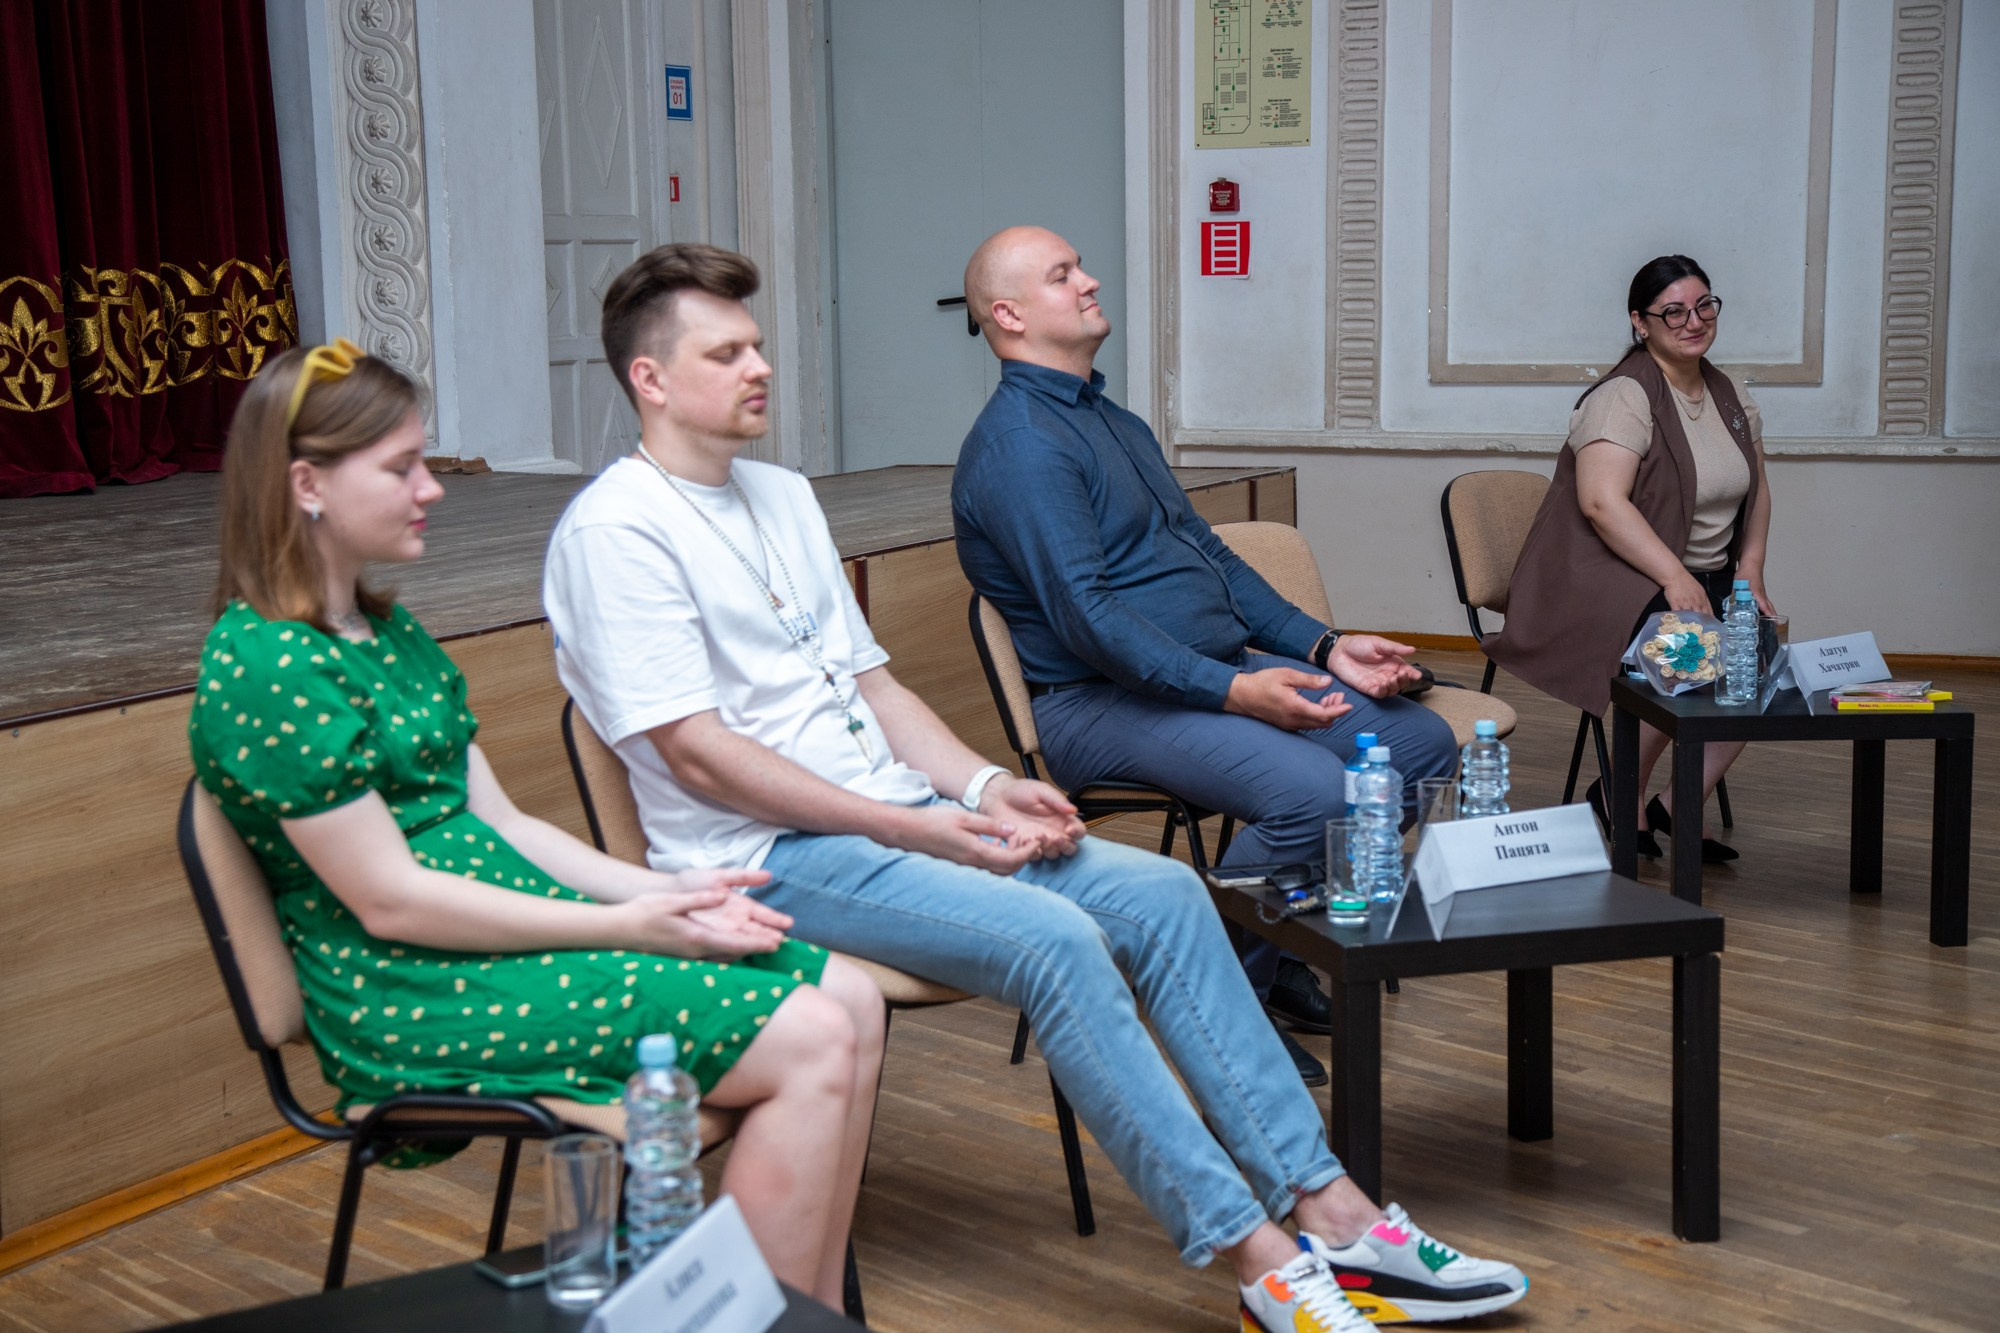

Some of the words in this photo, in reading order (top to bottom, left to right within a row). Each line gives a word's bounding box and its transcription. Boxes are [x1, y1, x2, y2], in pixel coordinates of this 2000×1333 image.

[673, 92, 682, 105] 01
[1818, 660, 1861, 673] Хачатрян
[1494, 821, 1539, 837] Антон
